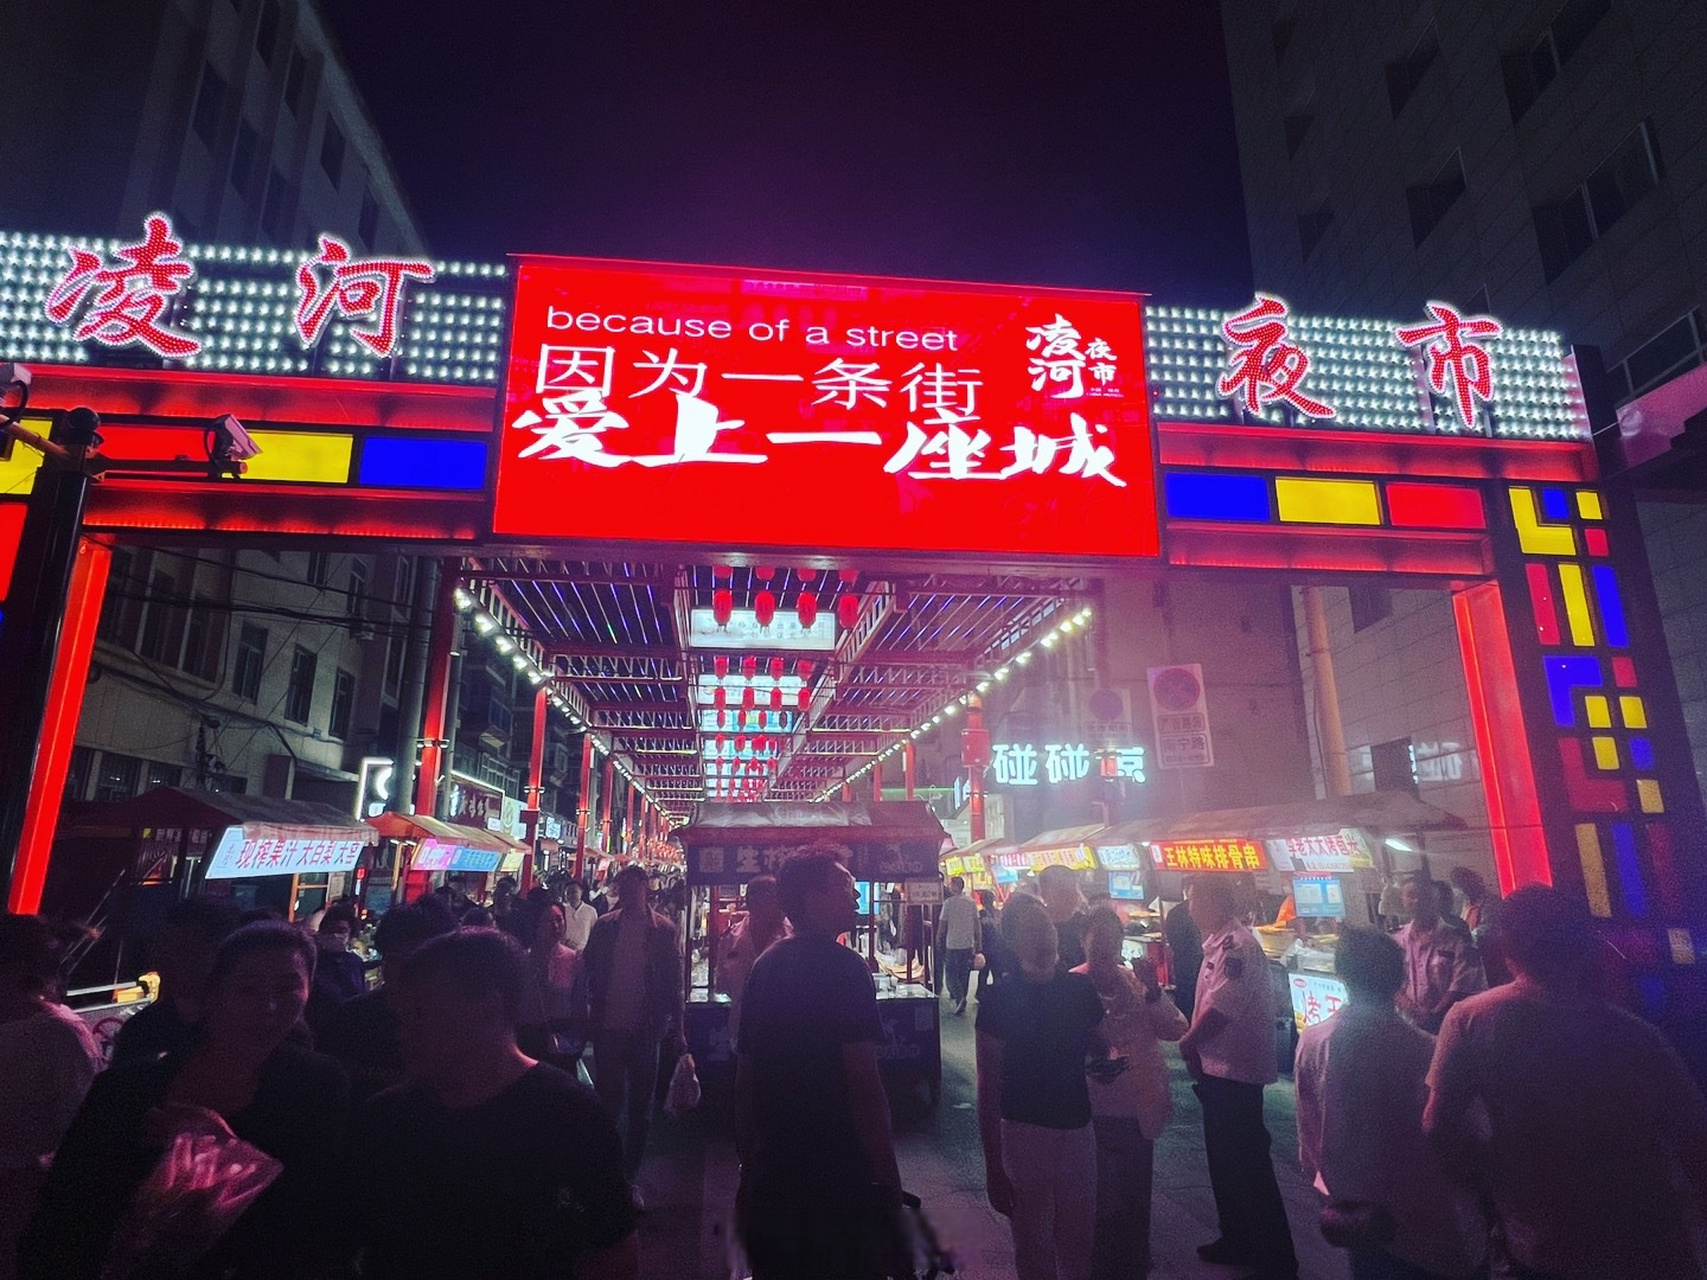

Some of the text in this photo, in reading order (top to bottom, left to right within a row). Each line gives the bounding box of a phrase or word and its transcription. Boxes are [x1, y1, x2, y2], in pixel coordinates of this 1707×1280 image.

[45, 211, 437, 360] 凌河
[547, 305, 958, 351] because of a street
[535, 343, 984, 417] 因为一条街
[1216, 292, 1504, 429] 夜市
[511, 388, 1127, 487] 爱上一座城
[1163, 843, 1260, 869] 王林特味排骨串
